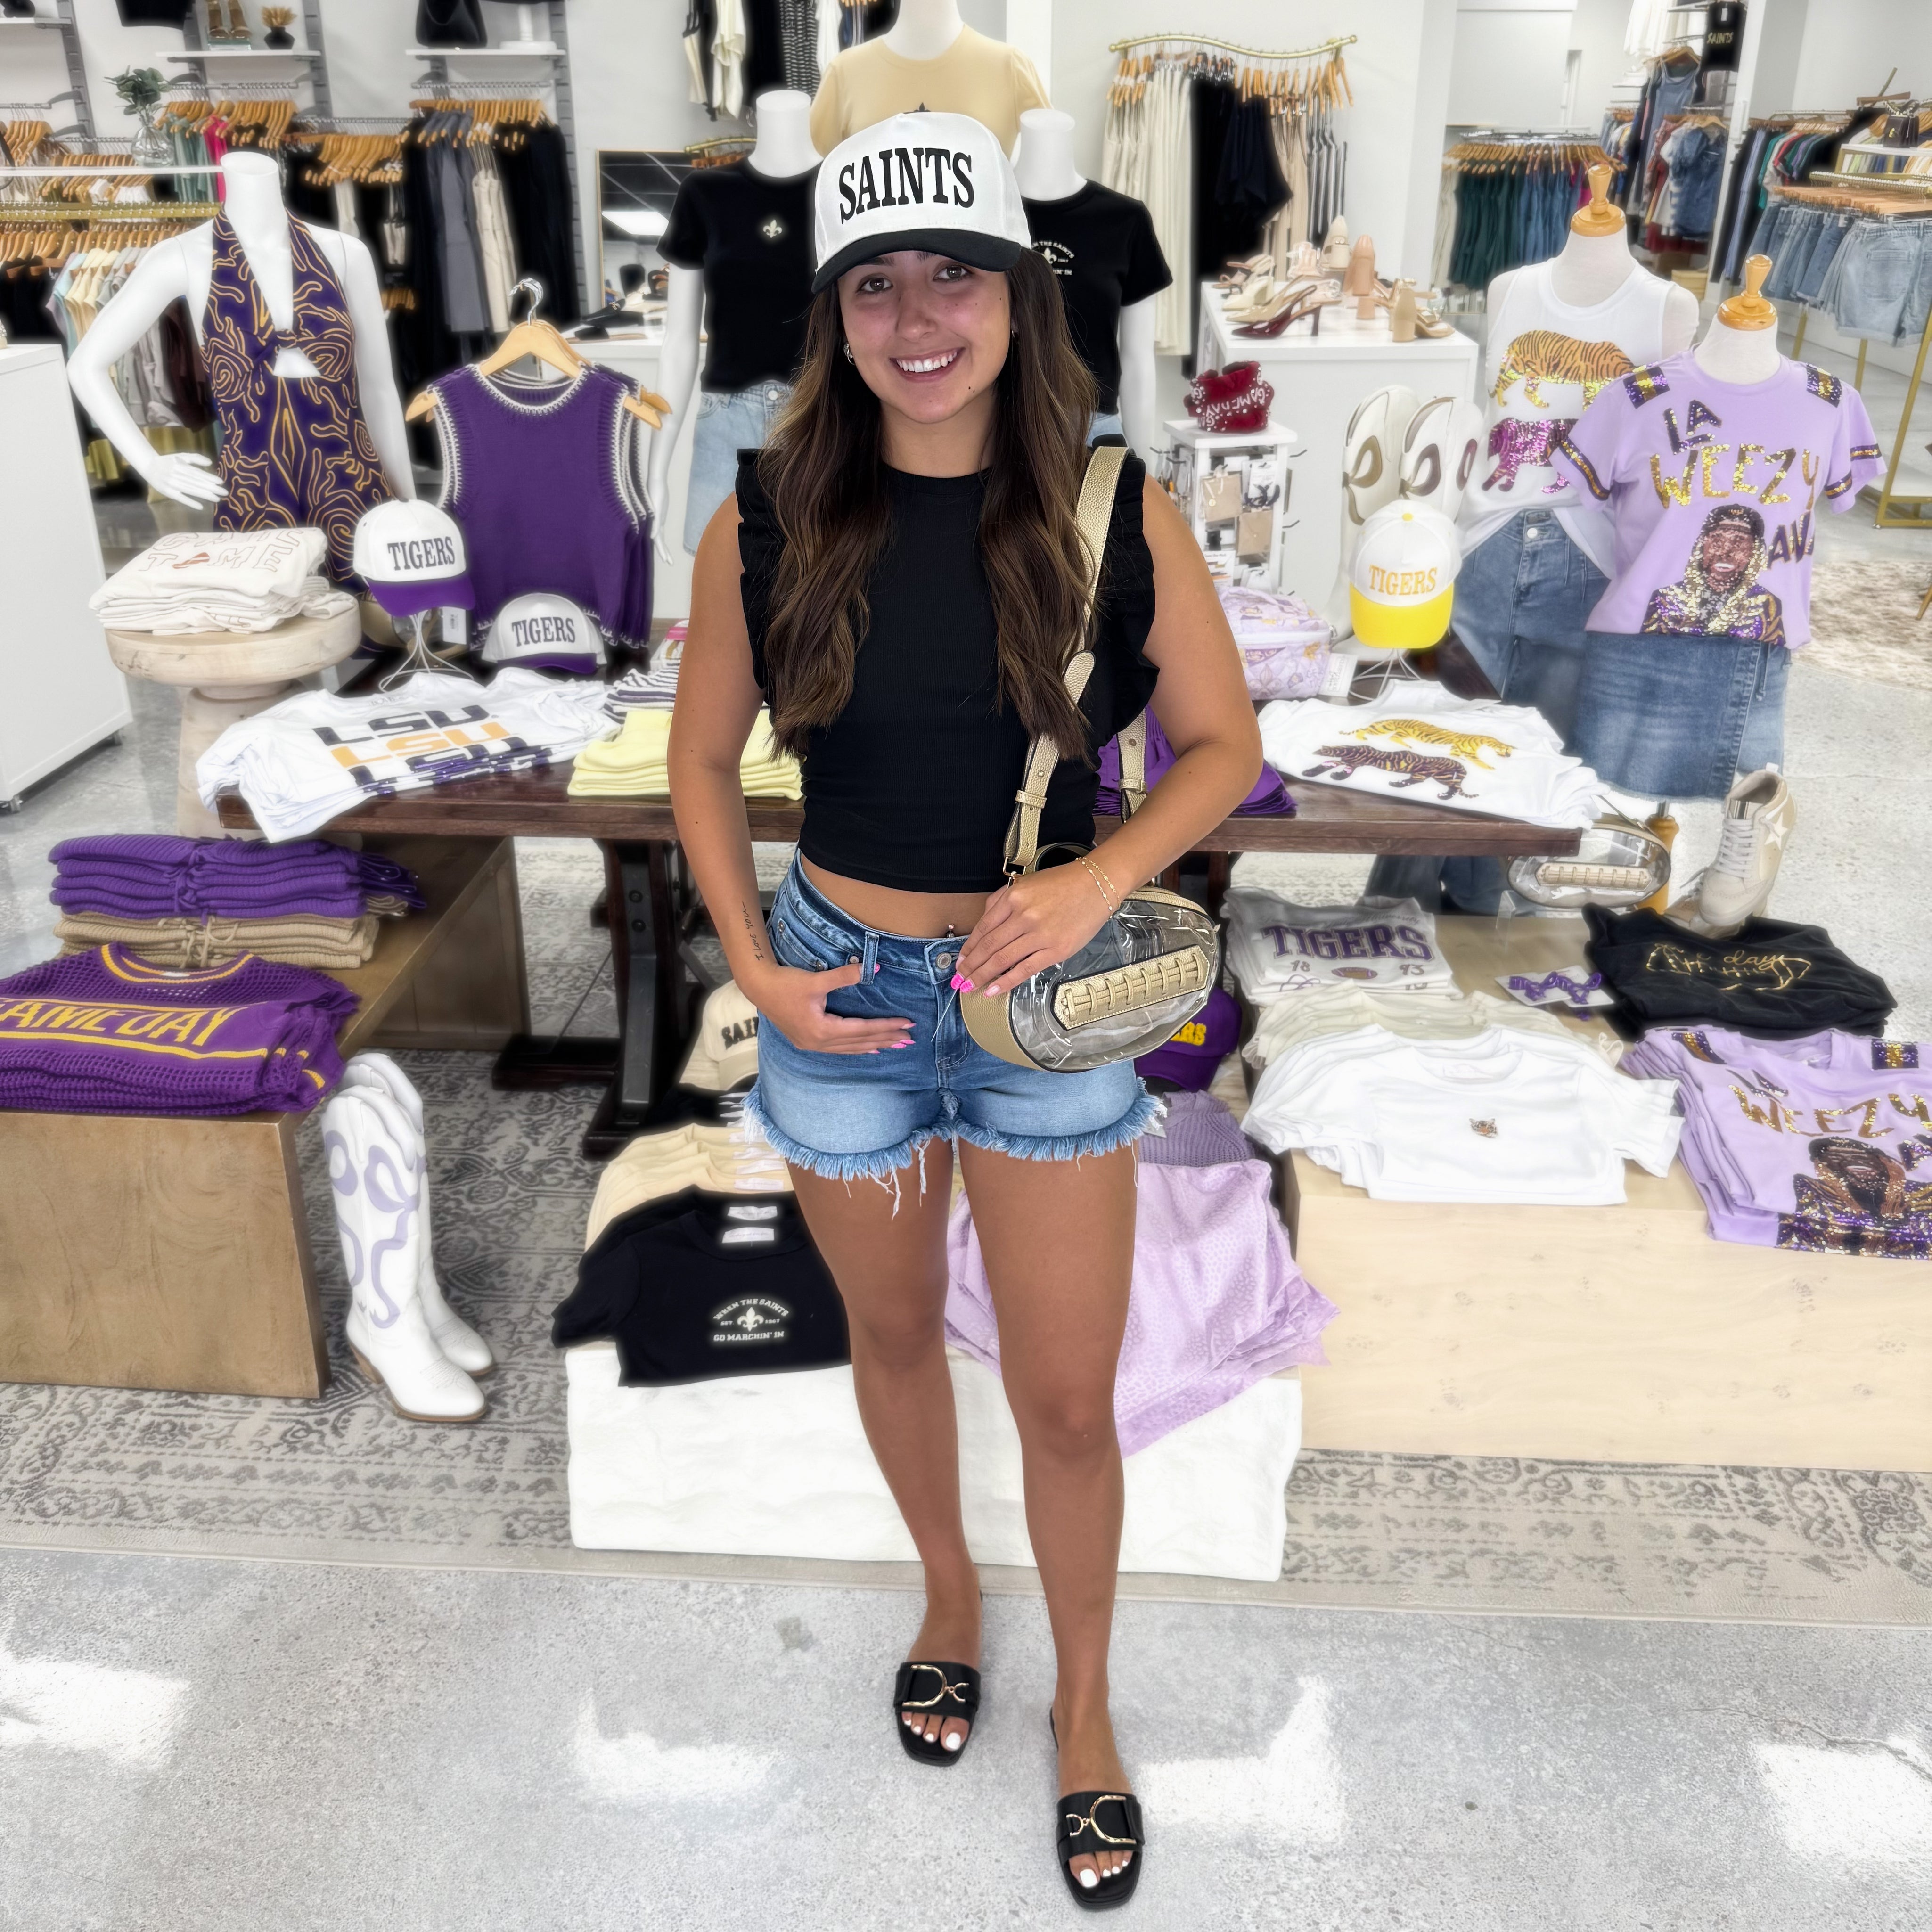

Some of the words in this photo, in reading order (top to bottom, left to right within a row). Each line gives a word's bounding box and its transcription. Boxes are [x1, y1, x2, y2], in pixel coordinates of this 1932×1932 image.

[839, 147, 974, 224] SAINTS
[1663, 400, 1723, 455] LA
[1650, 443, 1820, 510] WEEZY
[387, 536, 455, 571] TIGERS
[1369, 565, 1437, 596] TIGERS
[511, 616, 576, 647] TIGERS
[312, 704, 490, 746] LSU
[330, 722, 510, 769] LSU
[1261, 924, 1435, 962] TIGERS
[1290, 959, 1310, 972] 18
[0, 1001, 248, 1046] AMEDAY
[713, 1302, 739, 1320] WHEN
[759, 1299, 789, 1317] SAINTS
[727, 1332, 773, 1341] MARCHIN'
[773, 1331, 785, 1339] IN
